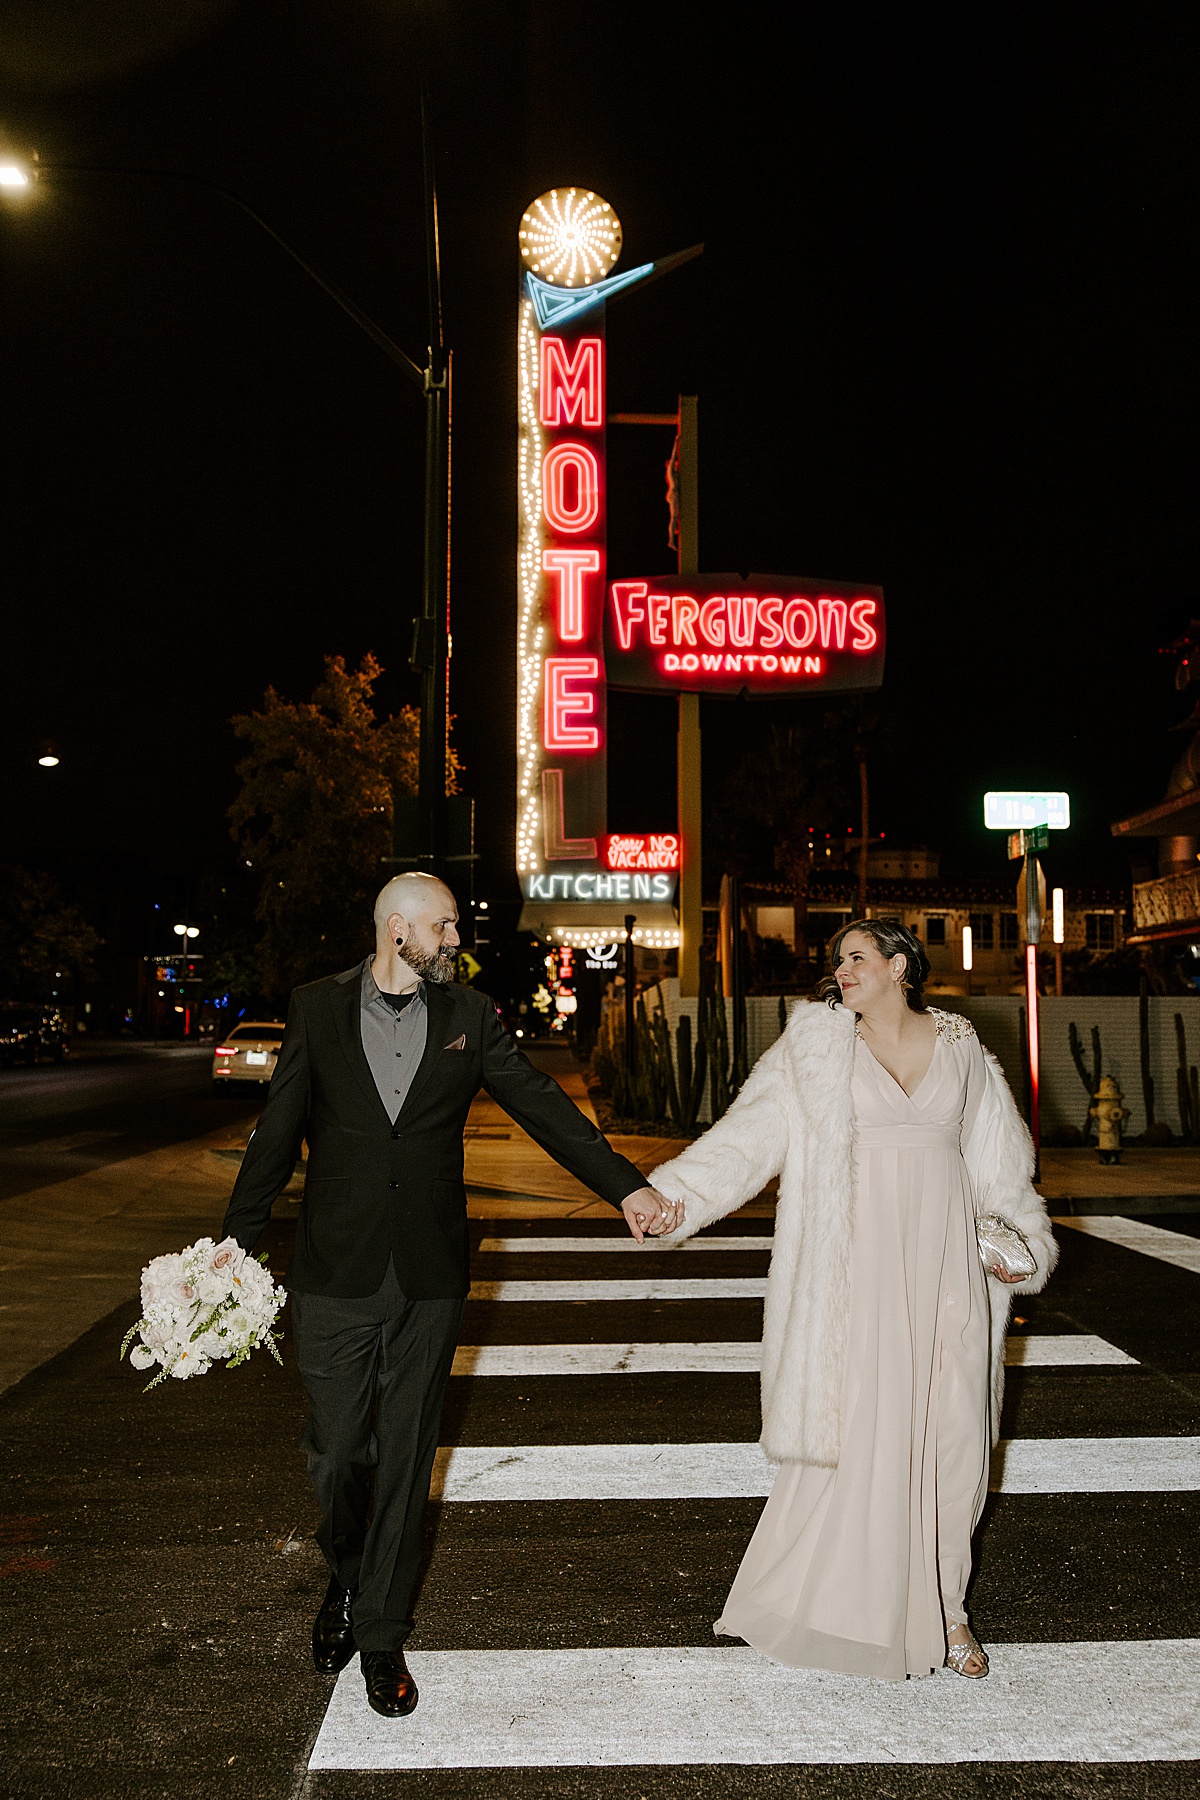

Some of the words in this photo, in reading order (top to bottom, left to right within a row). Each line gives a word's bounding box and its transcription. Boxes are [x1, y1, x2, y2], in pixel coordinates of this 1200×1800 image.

[539, 336, 604, 861] MOTEL
[664, 653, 822, 674] DOWNTOWN
[650, 835, 678, 851] NO
[607, 851, 679, 868] VACANCY
[528, 874, 670, 899] KITCHENS
